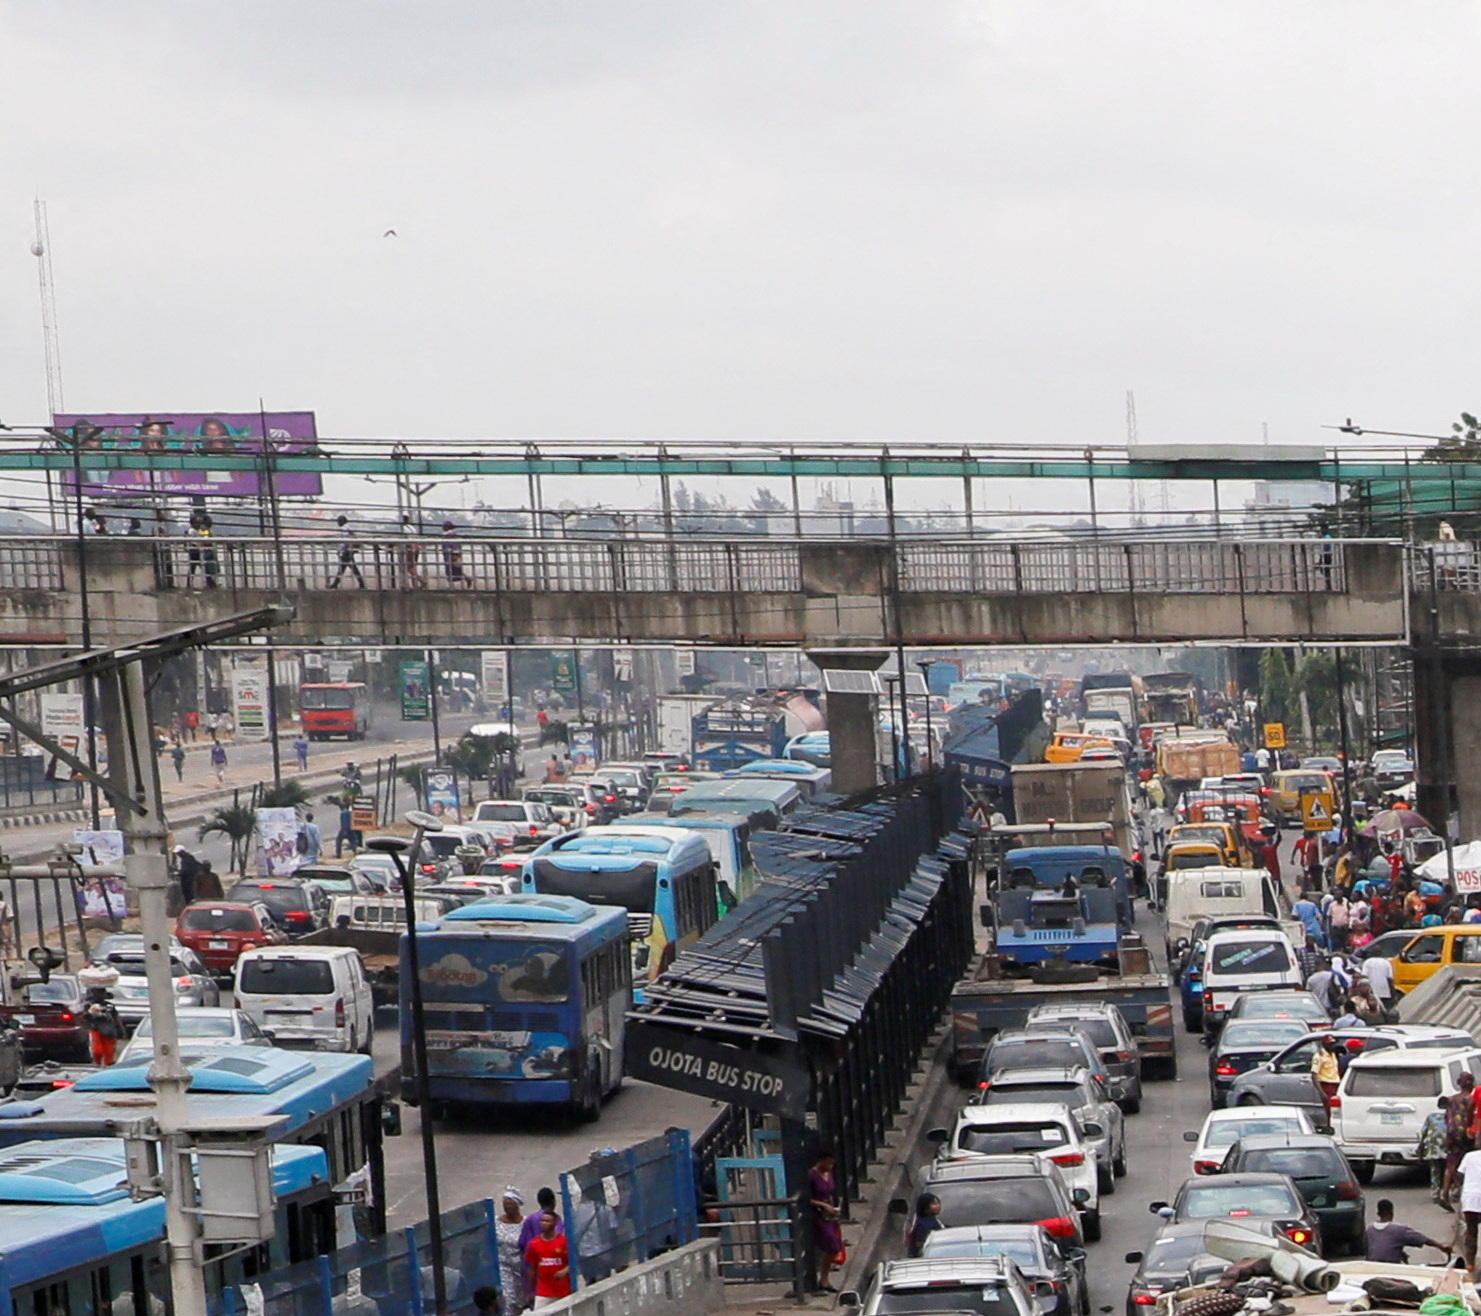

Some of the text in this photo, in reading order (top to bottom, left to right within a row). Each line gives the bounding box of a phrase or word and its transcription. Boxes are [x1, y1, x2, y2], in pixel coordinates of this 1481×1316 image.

[1457, 870, 1480, 886] POS
[649, 1047, 784, 1097] OJOTA BUS STOP
